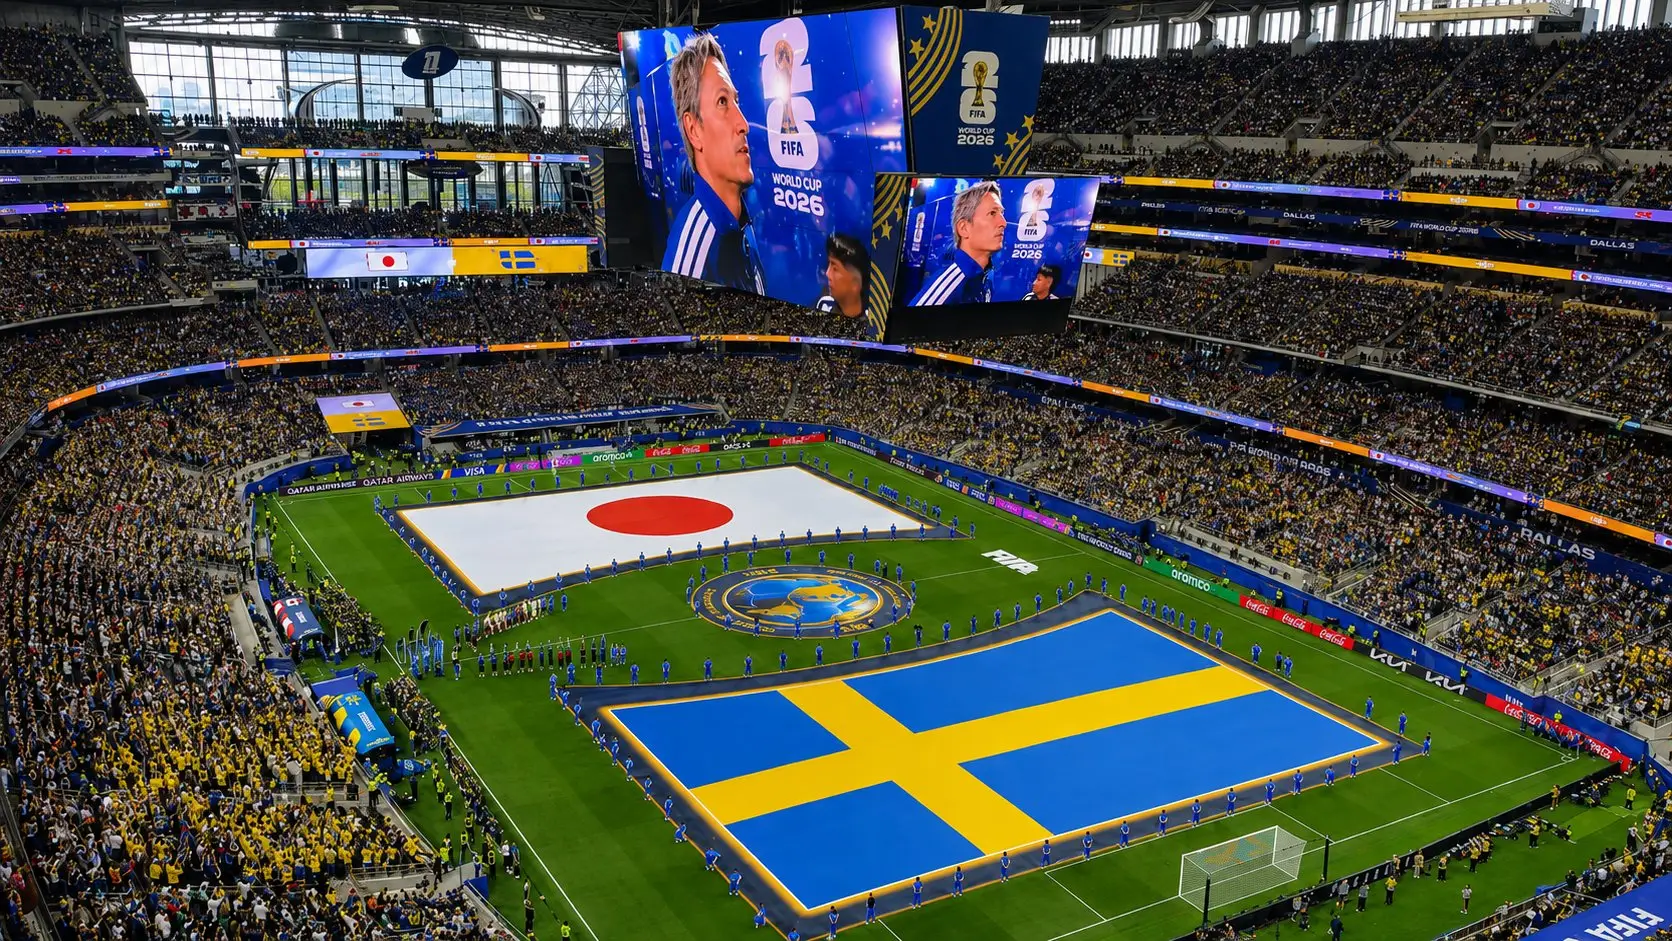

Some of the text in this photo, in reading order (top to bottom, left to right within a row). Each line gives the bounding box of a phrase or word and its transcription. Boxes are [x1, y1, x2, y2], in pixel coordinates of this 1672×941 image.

[969, 110, 986, 118] FIFA
[957, 134, 995, 146] 2026
[780, 140, 804, 156] FIFA
[772, 172, 822, 193] WORLD CUP
[773, 187, 825, 217] 2026
[1283, 212, 1315, 220] DALLAS
[1590, 239, 1635, 250] DALLAS
[1011, 249, 1043, 259] 2026
[464, 467, 485, 476] VISA
[363, 472, 434, 487] QATAR AIRWAYS
[287, 486, 315, 495] QATAR
[1584, 907, 1664, 941] FIFA
